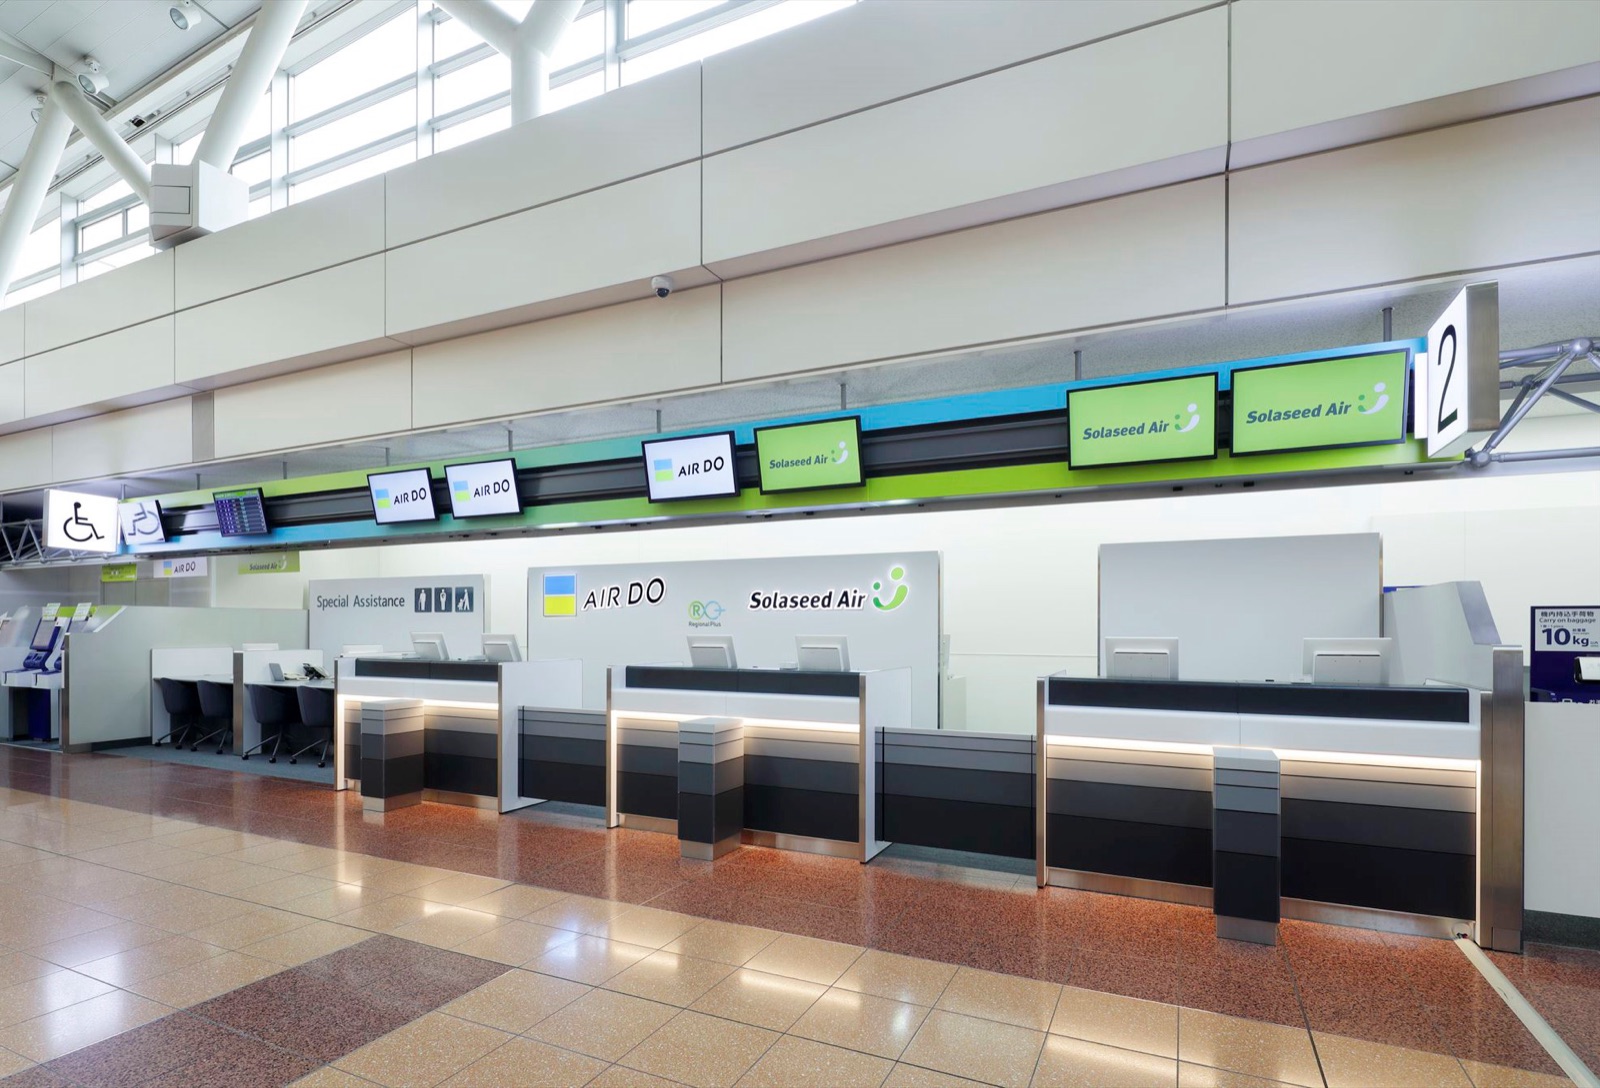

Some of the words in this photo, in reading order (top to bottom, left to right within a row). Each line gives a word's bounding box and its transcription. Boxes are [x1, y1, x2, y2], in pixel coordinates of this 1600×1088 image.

[1437, 324, 1458, 434] 2
[1246, 404, 1322, 424] Solaseed
[1325, 401, 1352, 417] Air
[1082, 423, 1145, 440] Solaseed
[1148, 420, 1170, 434] Air
[678, 463, 700, 477] AIR
[704, 456, 725, 473] DO
[769, 456, 812, 470] Solaseed
[814, 454, 828, 466] Air
[393, 492, 410, 505] AIR
[411, 487, 427, 502] DO
[473, 484, 491, 498] AIR
[493, 479, 510, 494] DO
[174, 563, 185, 574] AIR
[185, 561, 196, 572] DO
[316, 594, 349, 611] Special
[353, 594, 406, 608] Assistance
[583, 586, 621, 610] AIR
[627, 577, 665, 605] DO
[749, 591, 833, 609] Solaseed
[837, 589, 866, 608] Air
[1542, 628, 1571, 646] 10
[1572, 635, 1590, 648] kg
